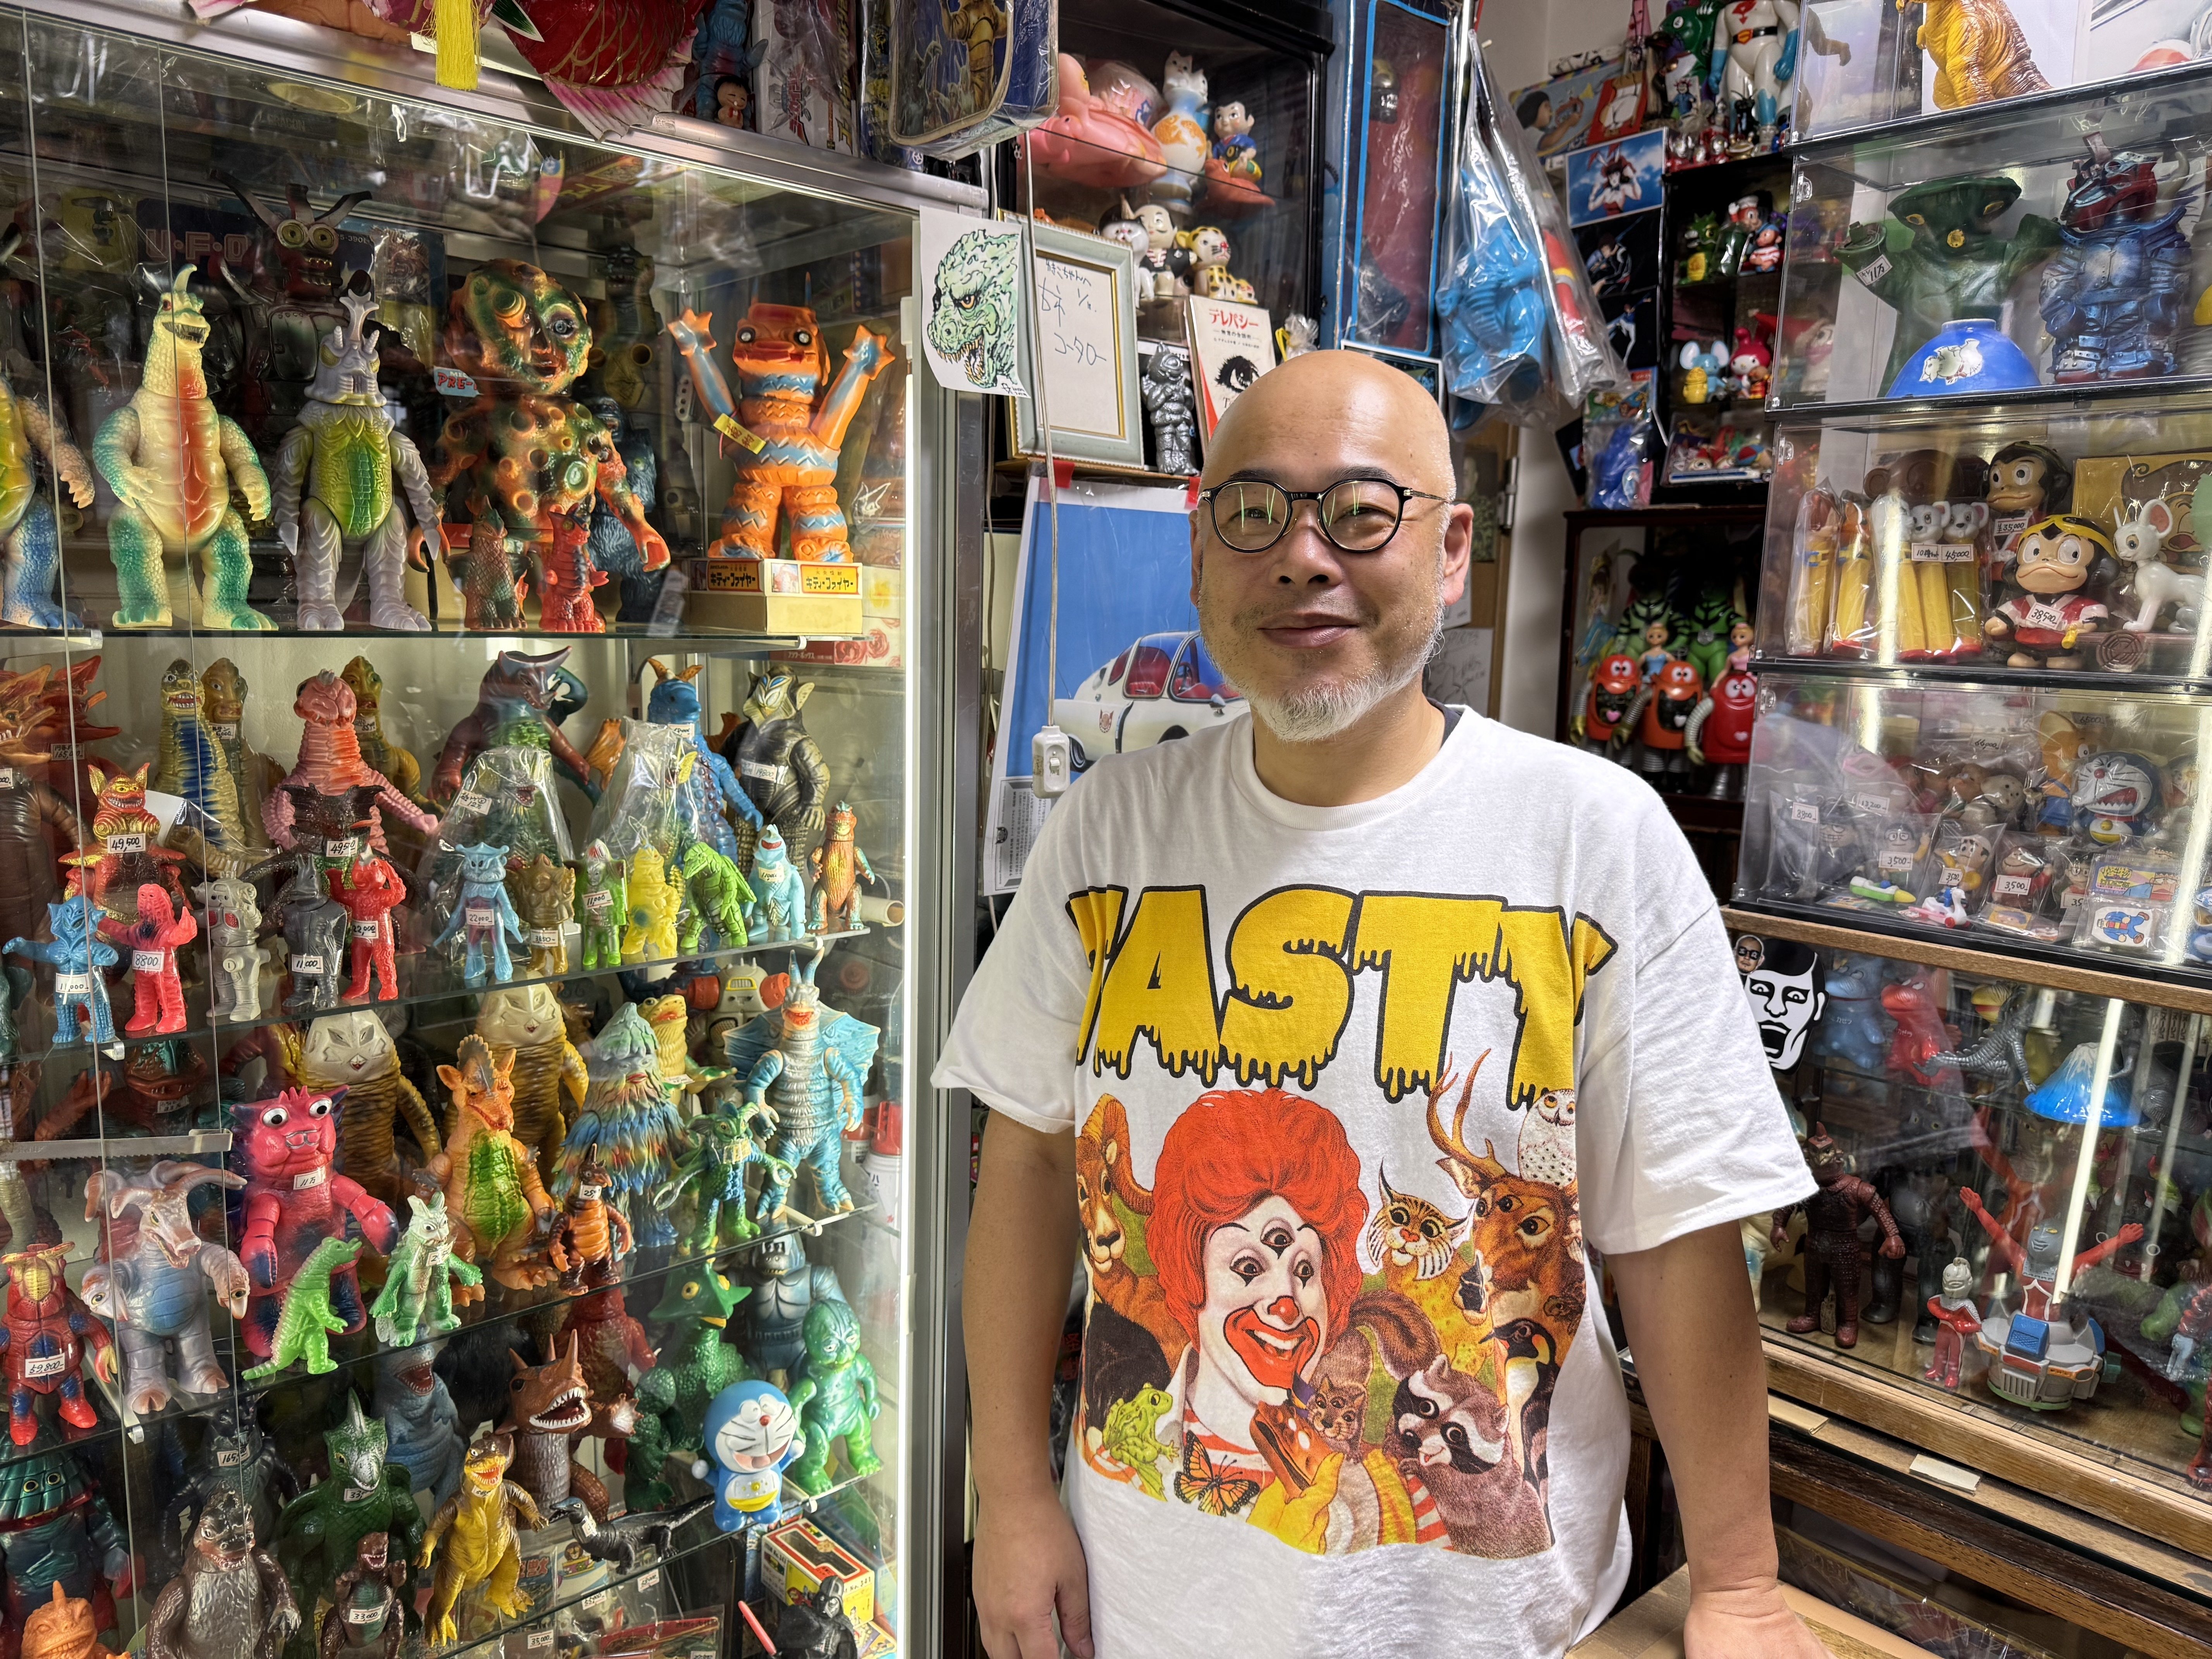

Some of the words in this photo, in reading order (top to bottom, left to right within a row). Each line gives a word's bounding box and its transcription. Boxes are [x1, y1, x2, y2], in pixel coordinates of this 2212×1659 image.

[1209, 309, 1259, 329] テレパシー
[437, 372, 477, 390] PRE-
